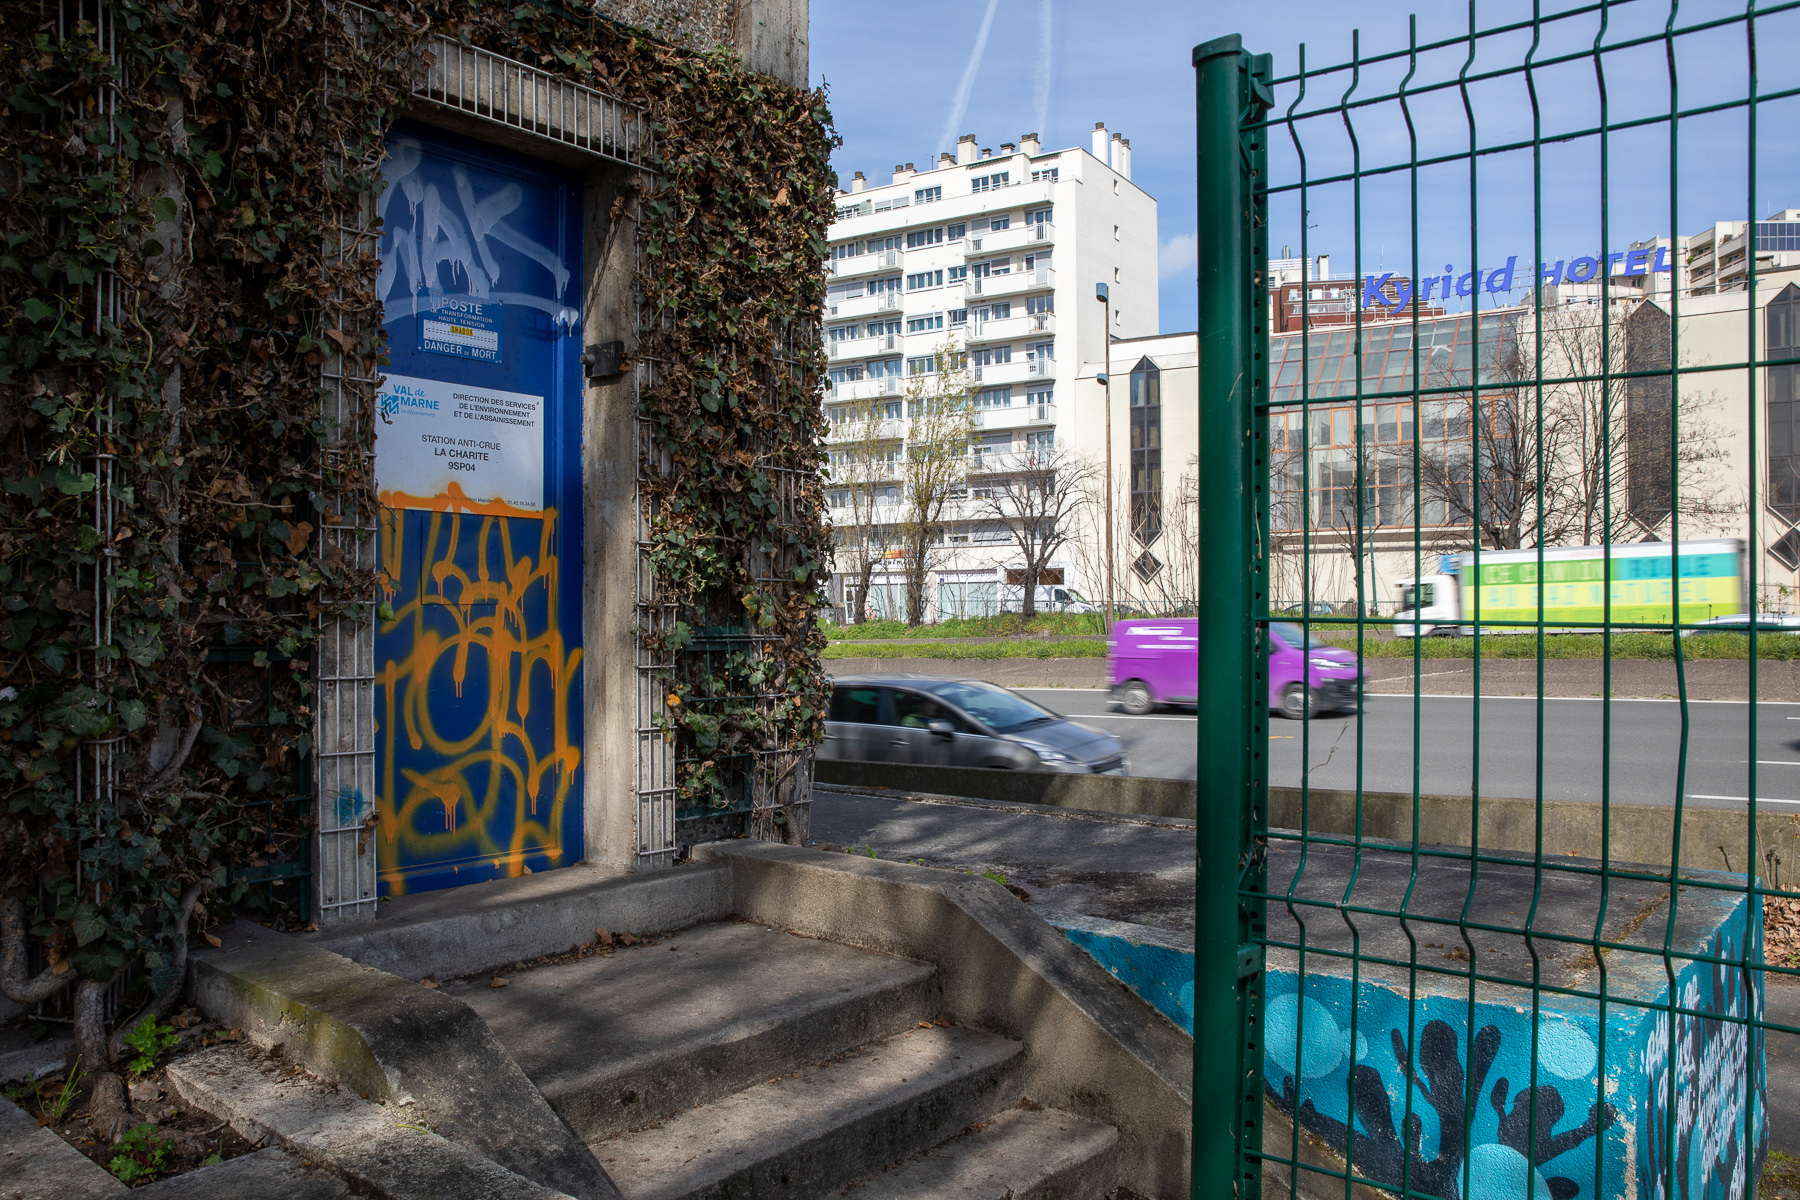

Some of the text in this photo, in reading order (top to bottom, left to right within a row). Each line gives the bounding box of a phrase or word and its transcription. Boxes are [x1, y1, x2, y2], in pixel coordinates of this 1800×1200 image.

[1361, 246, 1672, 314] Kyriad HOTEL
[441, 297, 483, 315] POSTE
[438, 315, 485, 328] HAUTE TENSION
[441, 309, 493, 324] TRANSFORMATION
[451, 325, 473, 336] SHADOK
[424, 340, 462, 355] DANGER
[471, 347, 497, 360] MORT
[393, 384, 426, 397] VAL de
[400, 396, 440, 411] MARNE
[452, 393, 536, 411] DIRECTION DES SERVICES
[408, 409, 436, 418] département
[469, 404, 531, 418] L'ENVIRONNEMENT
[474, 413, 535, 427] L'ASSAINISSEMENT
[421, 434, 501, 450] STATION ANTI-CRUE
[434, 447, 489, 461] LA CHARITE
[448, 462, 476, 472] 9SP04
